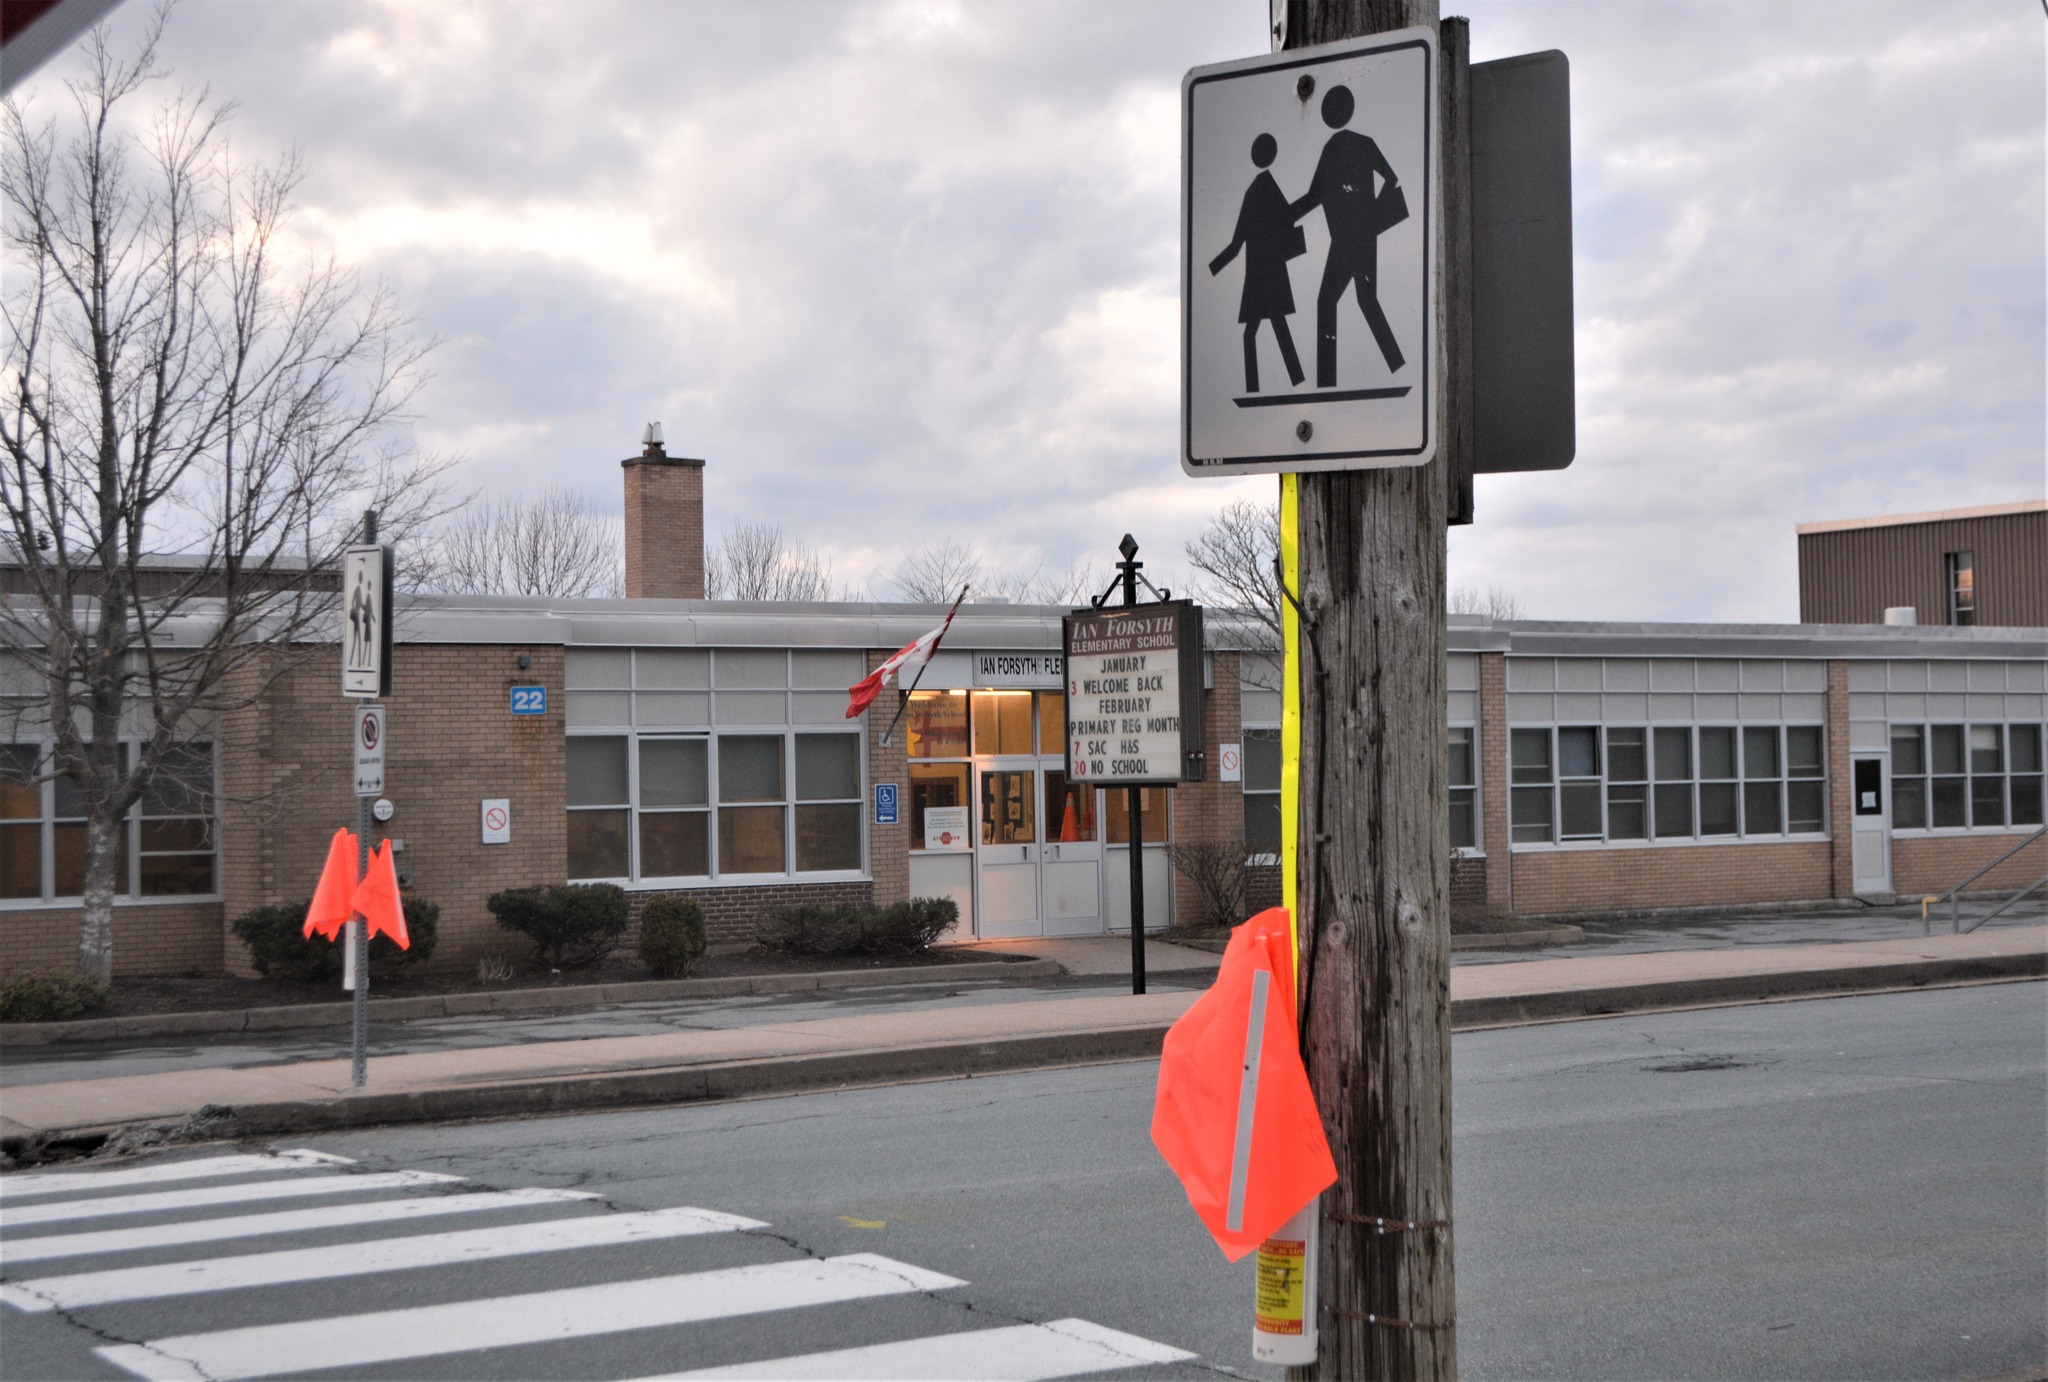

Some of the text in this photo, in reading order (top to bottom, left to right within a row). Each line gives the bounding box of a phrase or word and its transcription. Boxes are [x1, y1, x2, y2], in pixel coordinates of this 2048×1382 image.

[1107, 617, 1174, 637] FORSYTH
[1071, 634, 1175, 653] ELEMENTARY SCHOOL
[980, 657, 996, 675] IAN
[997, 657, 1037, 675] FORSYTH
[1101, 656, 1146, 673] JANUARY
[1071, 676, 1163, 696] 3 WELCOME BACK
[514, 691, 543, 710] 22
[1099, 697, 1151, 714] FEBRUARY
[1070, 716, 1180, 736] PRIMARY REG MONTH
[1074, 739, 1139, 756] 7 SAC H&S
[1074, 759, 1149, 775] 20 NO SCHOOL
